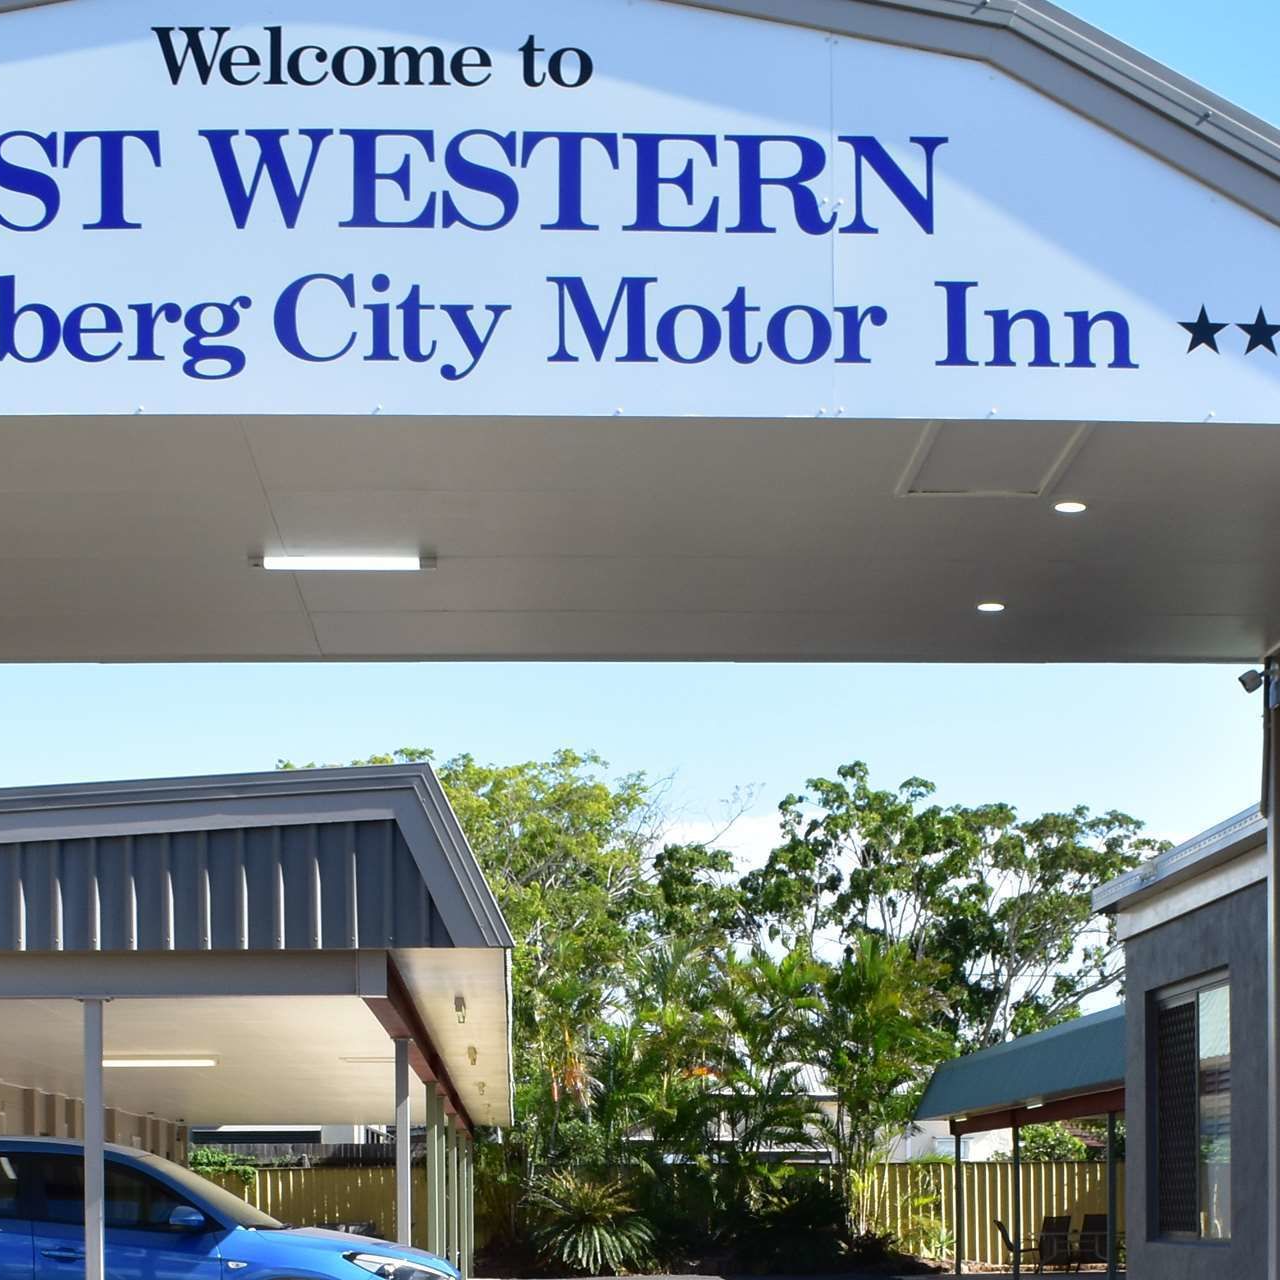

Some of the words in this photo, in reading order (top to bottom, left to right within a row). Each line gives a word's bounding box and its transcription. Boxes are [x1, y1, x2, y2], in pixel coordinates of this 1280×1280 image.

[152, 26, 492, 88] Welcome
[518, 34, 593, 88] to
[198, 128, 949, 236] WESTERN
[273, 273, 512, 381] City
[546, 276, 888, 365] Motor
[934, 280, 1139, 369] Inn
